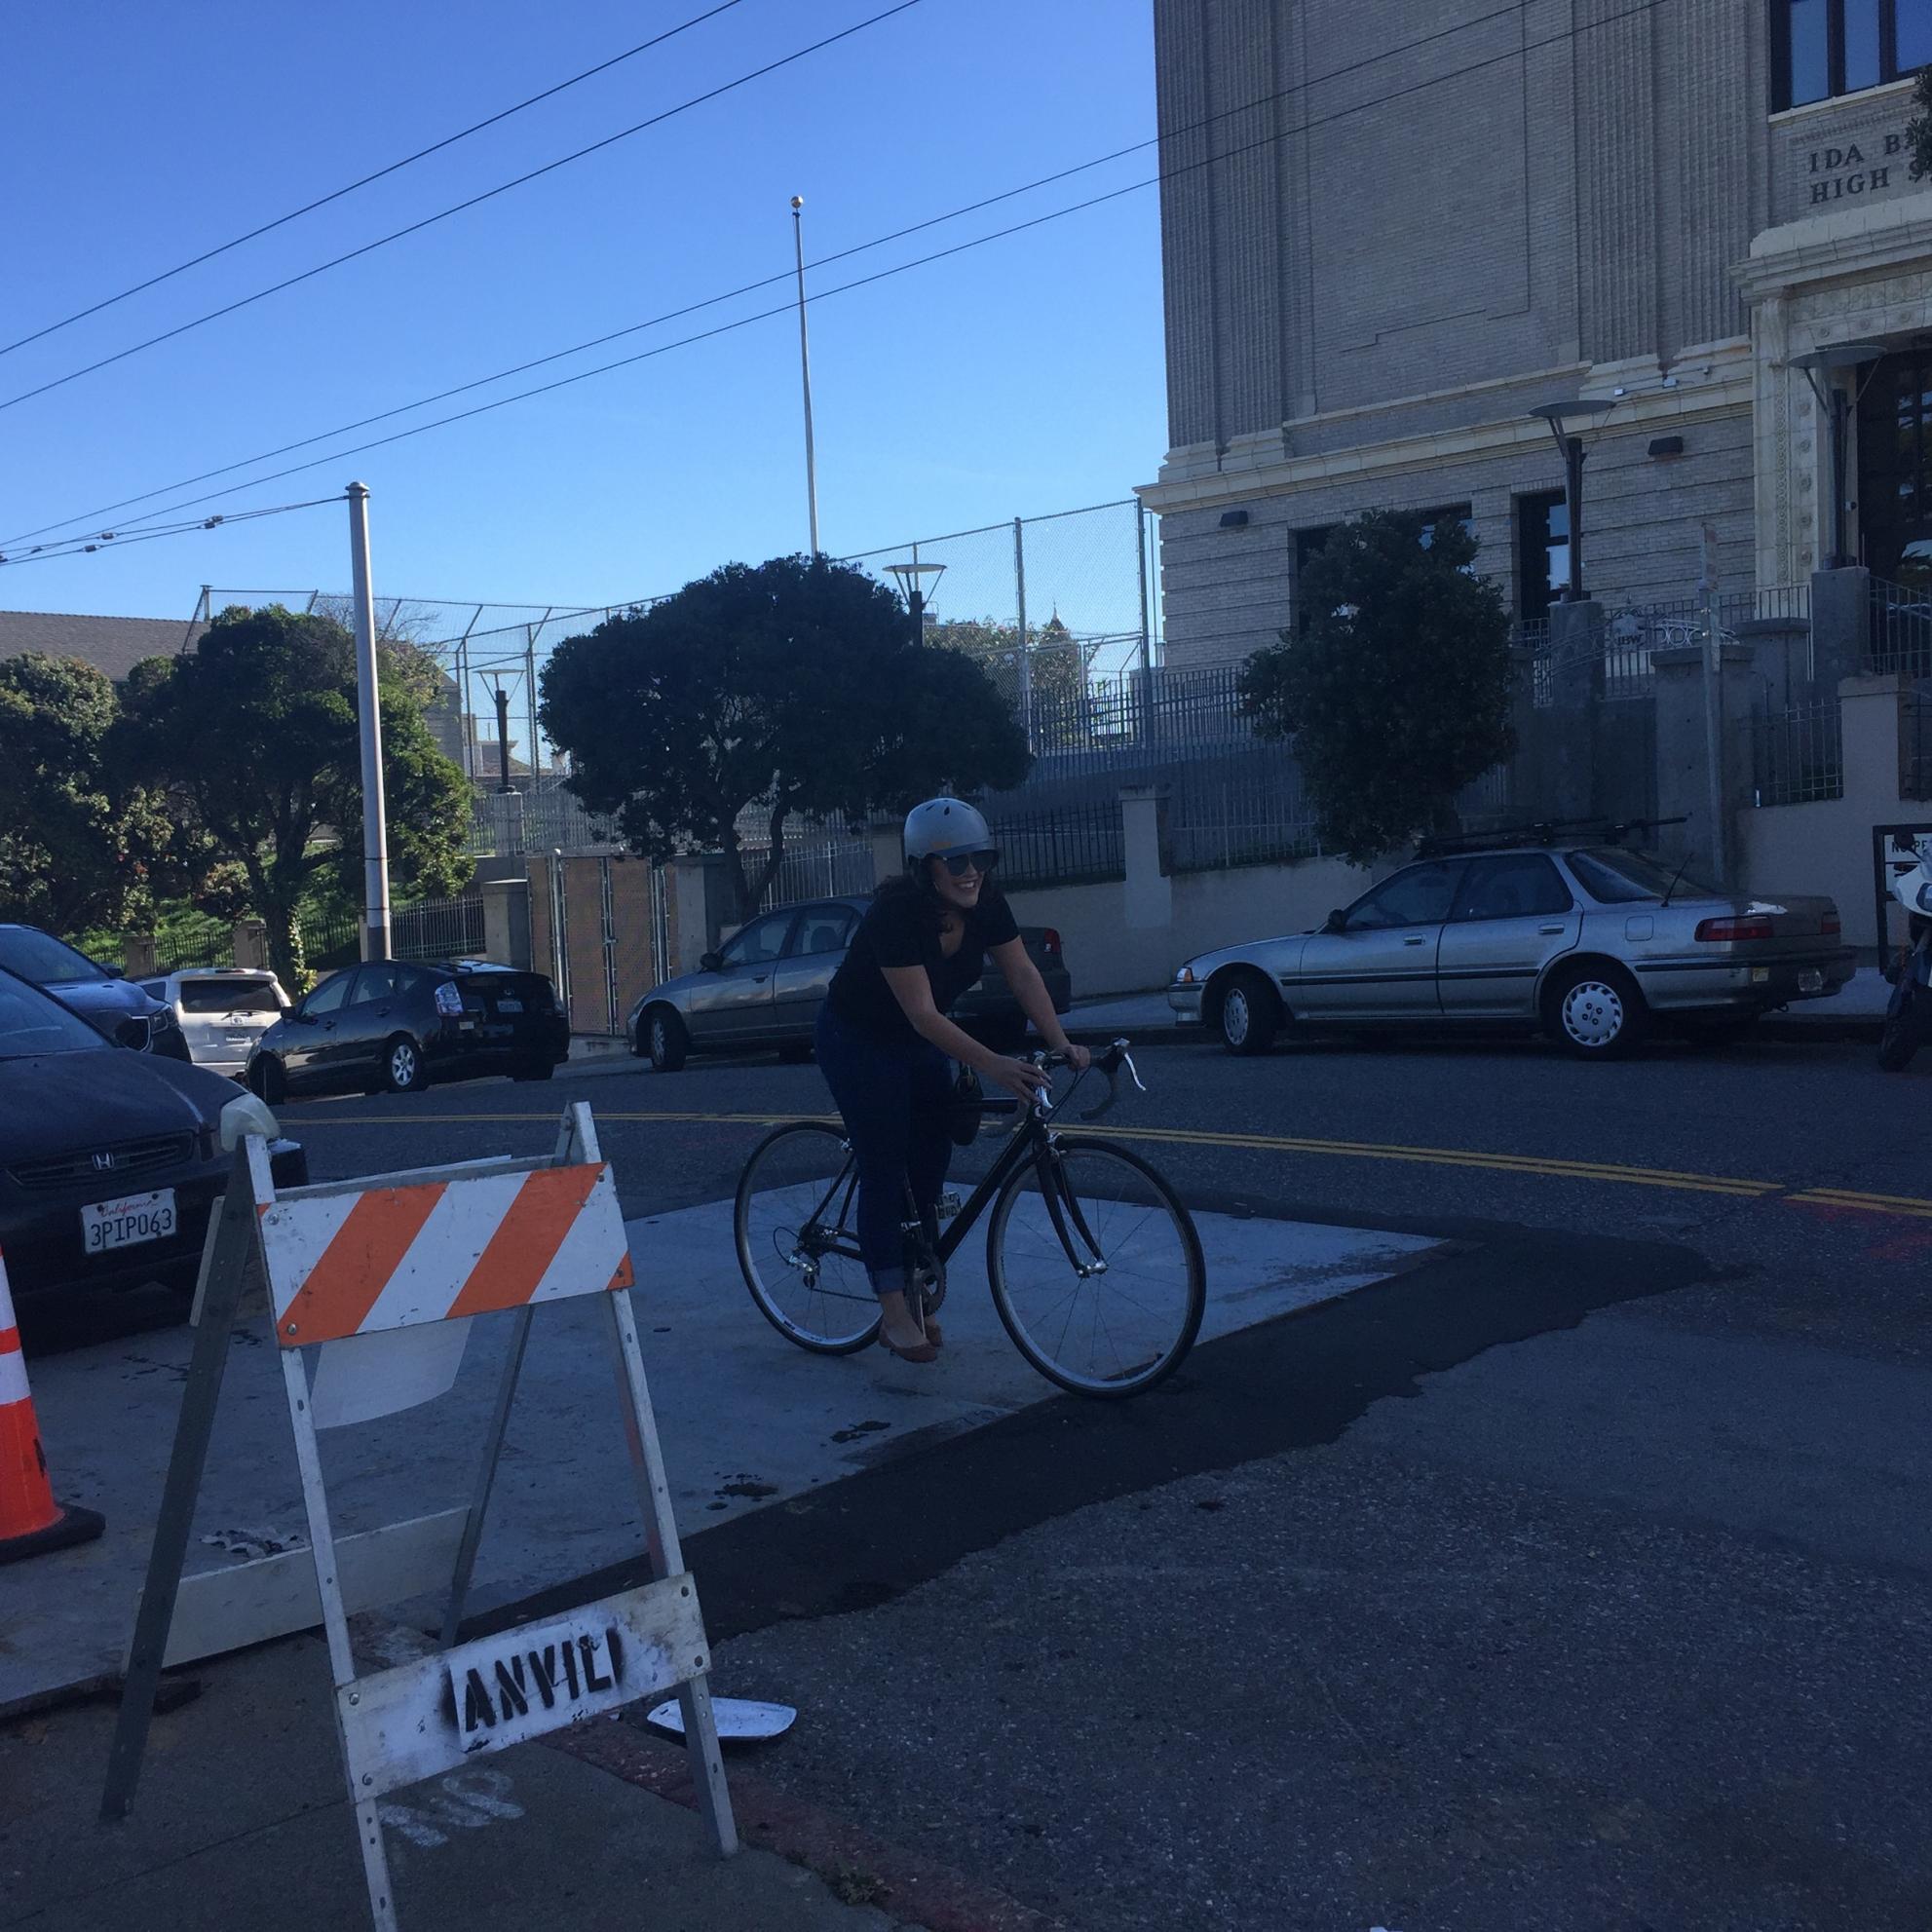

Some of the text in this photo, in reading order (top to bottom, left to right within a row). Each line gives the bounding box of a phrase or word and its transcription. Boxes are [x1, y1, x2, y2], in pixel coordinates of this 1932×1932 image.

[1809, 142, 1866, 173] IDA
[1810, 167, 1890, 205] HIGH
[91, 1207, 172, 1248] 3PIP063
[99, 1198, 157, 1219] California
[465, 1634, 612, 1732] ANVIL
